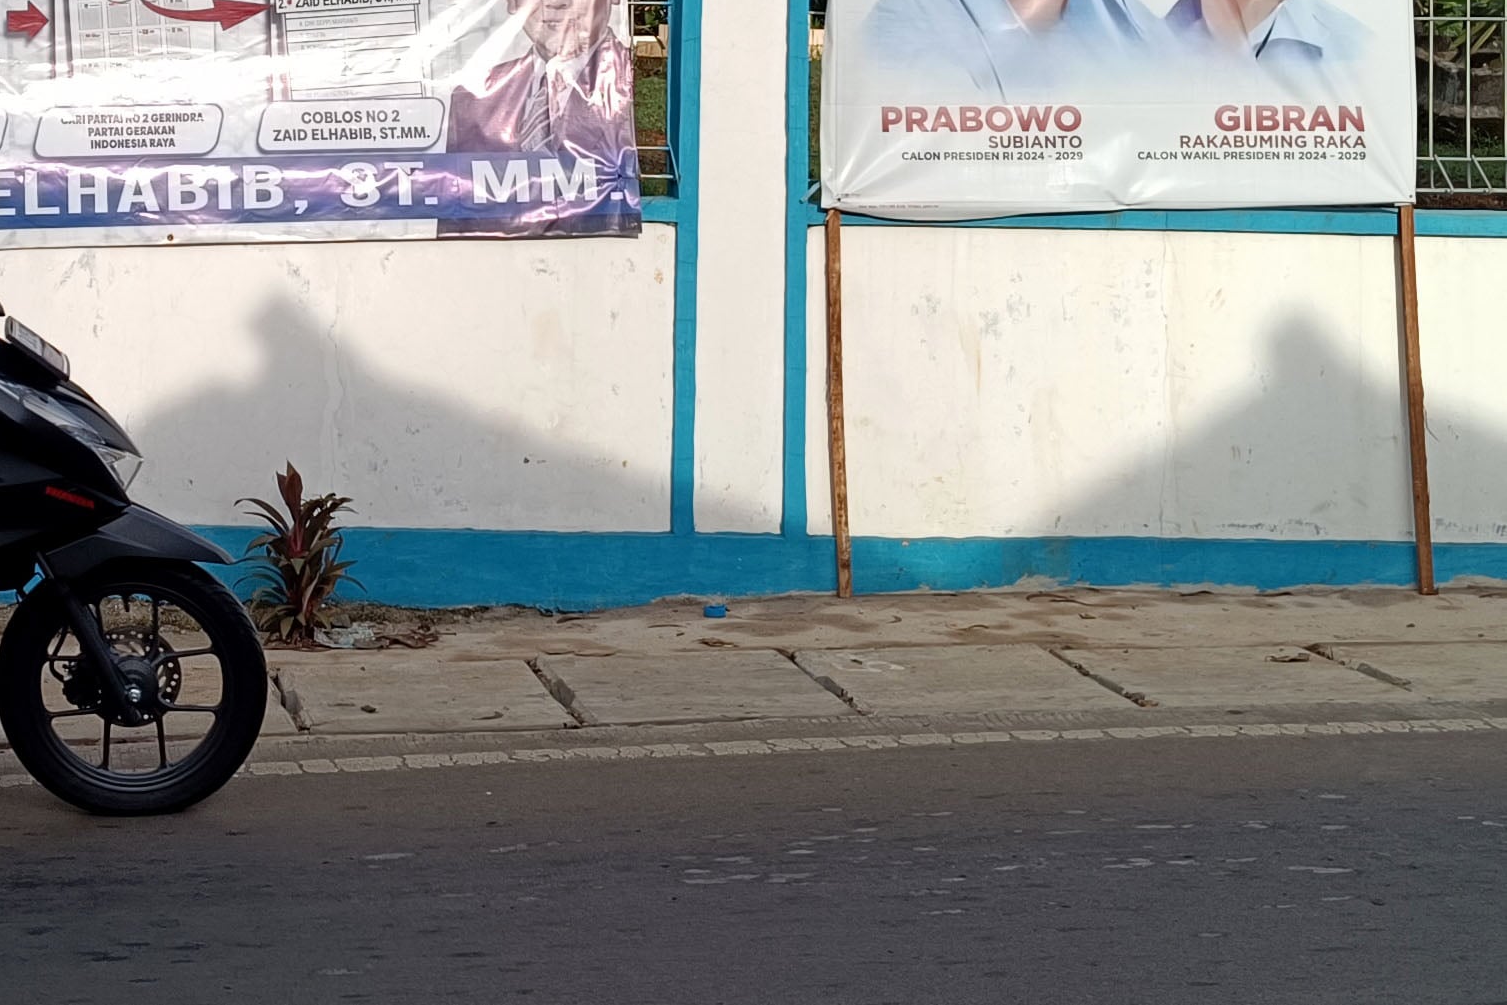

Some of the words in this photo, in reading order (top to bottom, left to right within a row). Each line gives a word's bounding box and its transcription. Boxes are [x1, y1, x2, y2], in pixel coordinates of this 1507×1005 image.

[278, 0, 287, 9] 2.
[88, 114, 123, 124] PARTAI
[142, 114, 149, 123] 2
[151, 112, 204, 122] GERINDRA
[301, 111, 362, 124] COBLOS
[366, 111, 388, 123] NO
[392, 110, 400, 122] 2
[881, 105, 1082, 132] PRABOWO
[1214, 105, 1365, 132] GIBRAN
[88, 126, 124, 137] PARTAI
[126, 125, 175, 135] GERAKAN
[273, 129, 307, 141] ZAID
[312, 128, 376, 141] ELHABIB,
[380, 127, 431, 139] ST.MM.
[90, 138, 148, 149] INDONESIA
[149, 138, 176, 148] RAYA
[988, 135, 1082, 149] SUBIANTO
[1179, 135, 1307, 149] RAKABUMING
[1313, 135, 1367, 149] RAKA
[902, 152, 941, 161] CALON
[944, 152, 1000, 161] PRESIDEN
[1003, 152, 1014, 161] RI
[1017, 152, 1044, 160] 2024
[1055, 152, 1083, 160] 2029
[1137, 151, 1178, 160] CALON
[1181, 151, 1220, 160] WAKIL
[1224, 151, 1280, 160] PRESIDEN
[1284, 151, 1294, 160] RI
[1298, 151, 1327, 160] 2024
[1338, 151, 1366, 160] 2029
[339, 160, 439, 208] ST.
[471, 157, 625, 205] MM.
